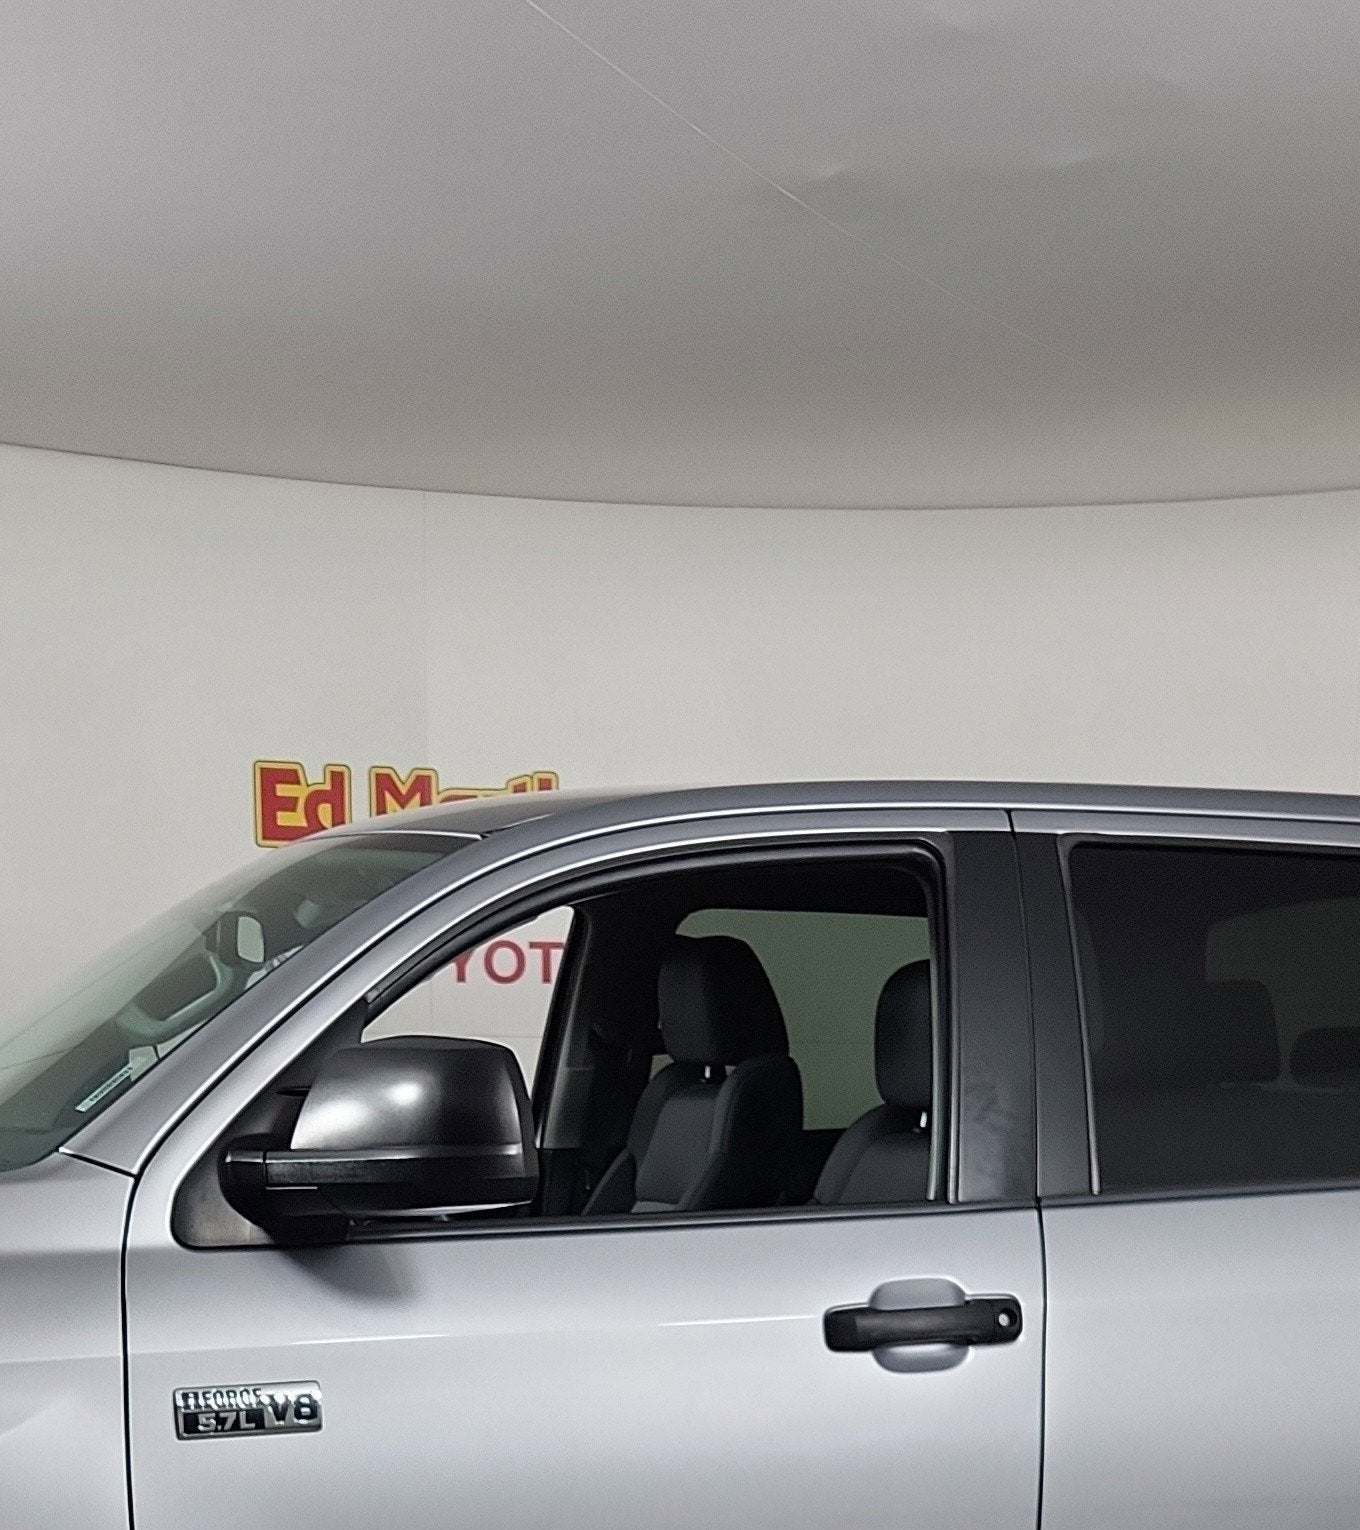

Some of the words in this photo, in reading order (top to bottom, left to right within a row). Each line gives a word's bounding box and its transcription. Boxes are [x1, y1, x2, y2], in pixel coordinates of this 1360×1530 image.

[254, 761, 351, 849] Ed
[197, 1410, 256, 1433] 5.7L
[262, 1392, 320, 1426] V8
